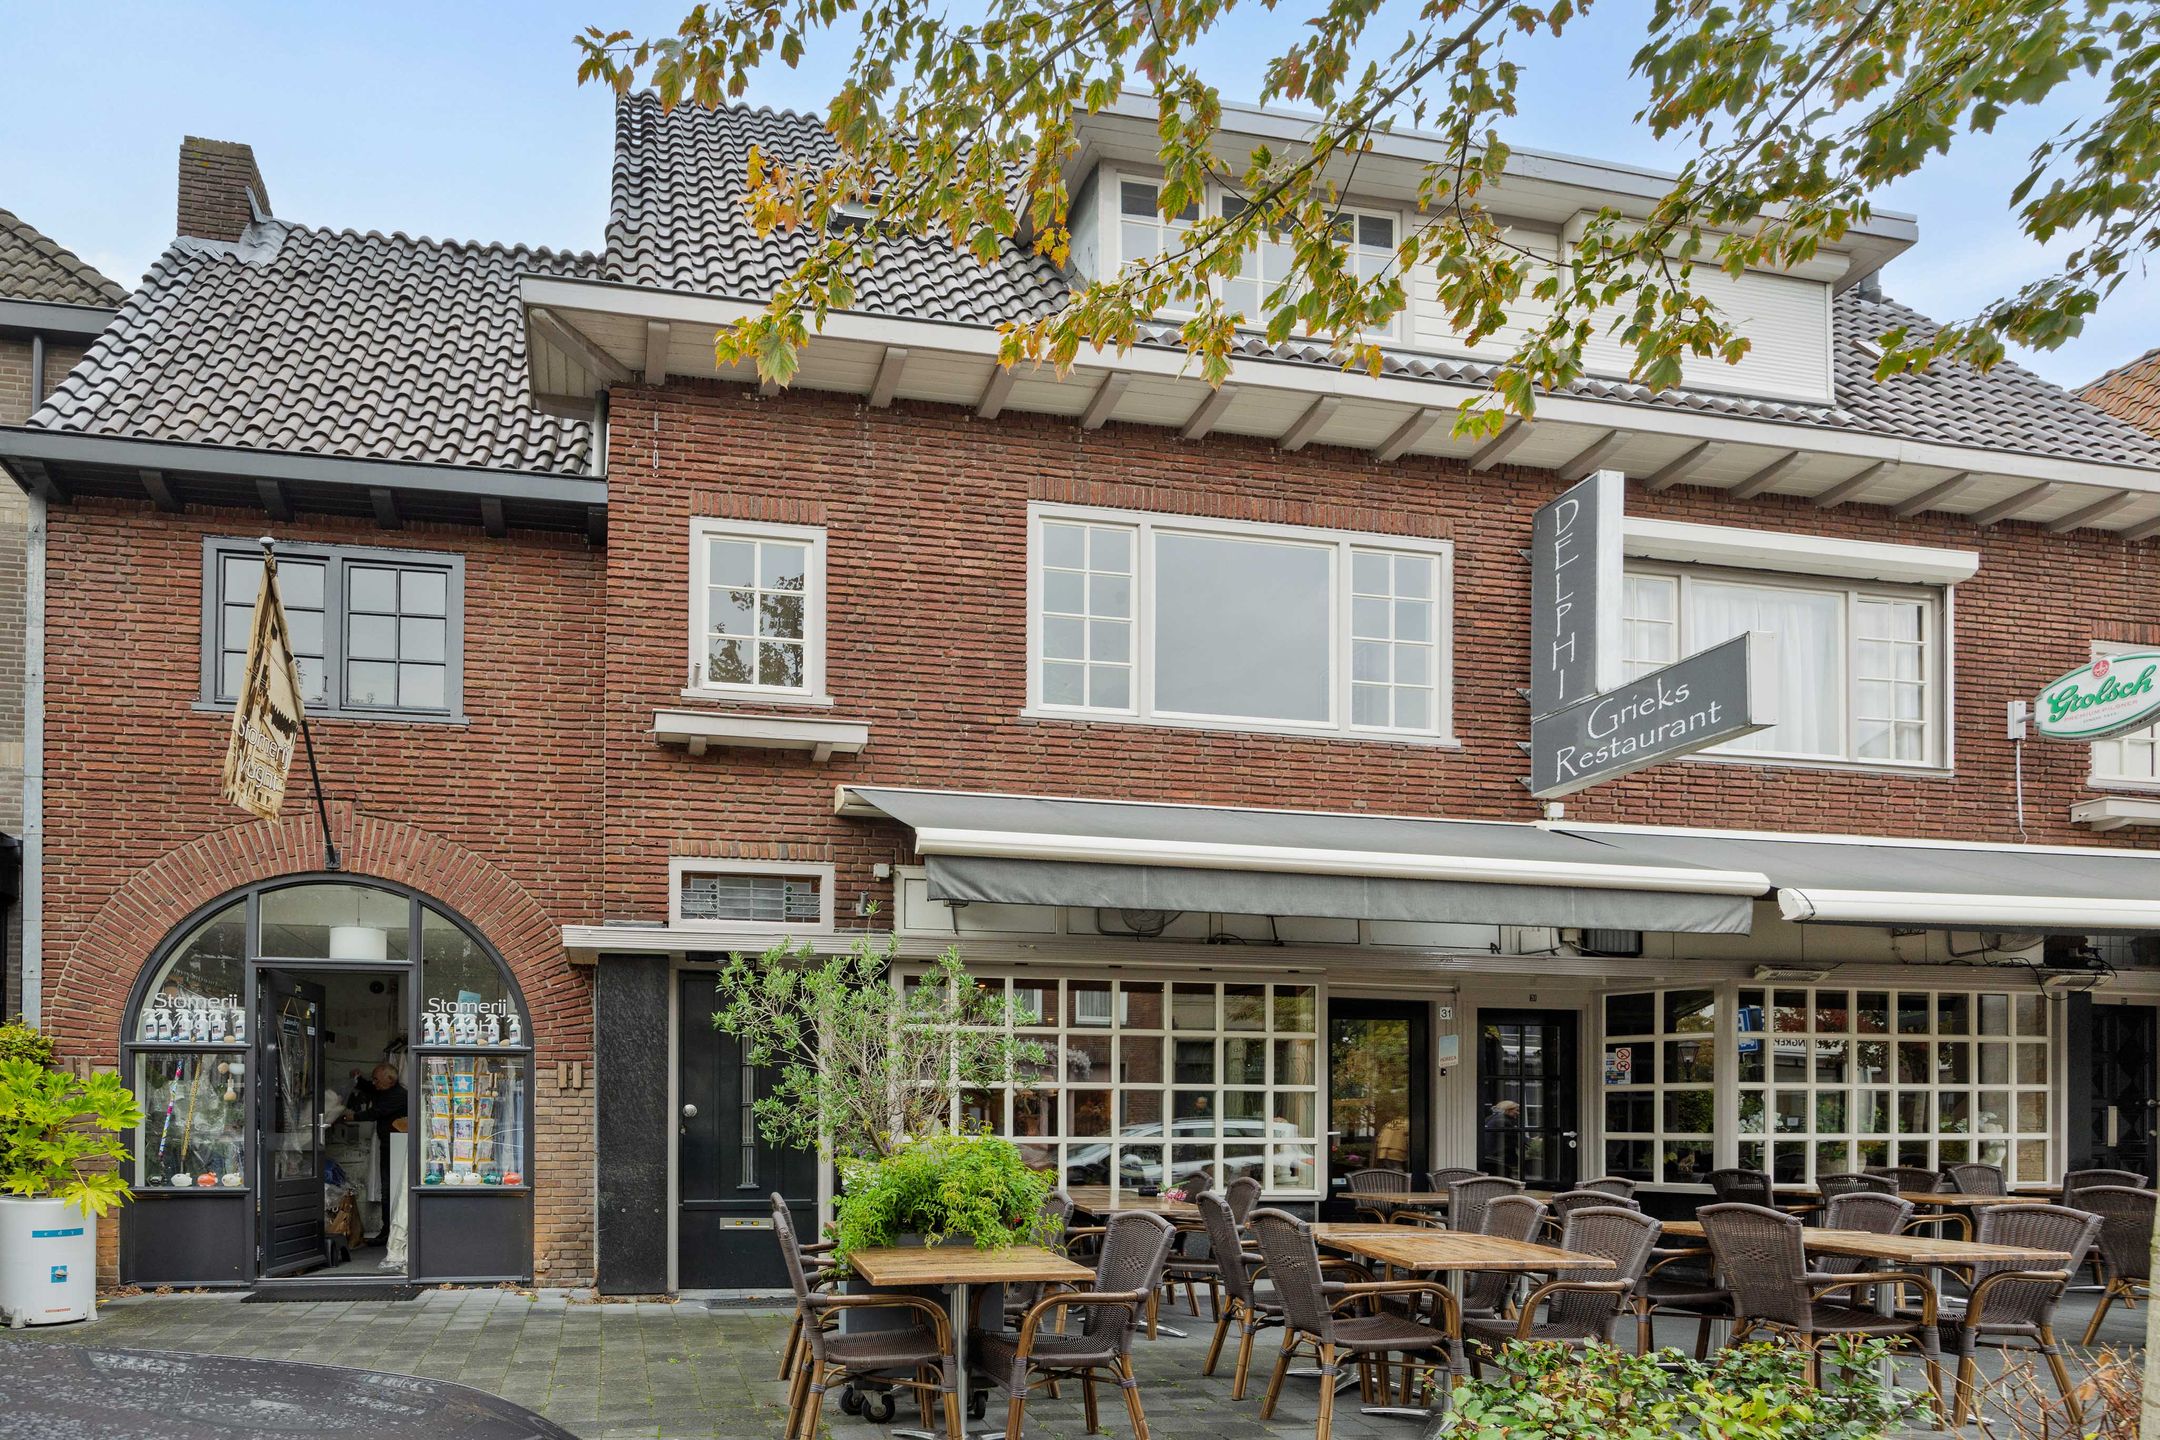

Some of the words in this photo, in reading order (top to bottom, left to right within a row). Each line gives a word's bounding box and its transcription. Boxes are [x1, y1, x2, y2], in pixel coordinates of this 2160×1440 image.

[1552, 499, 1580, 700] DELPHI
[1587, 677, 1690, 740] Grieks
[2047, 664, 2157, 723] Grolsch
[238, 714, 292, 770] Stomerij
[239, 749, 281, 791] Vught
[1555, 700, 1723, 783] Restaurant
[428, 997, 507, 1018] Stomerij
[1441, 1008, 1451, 1018] 31
